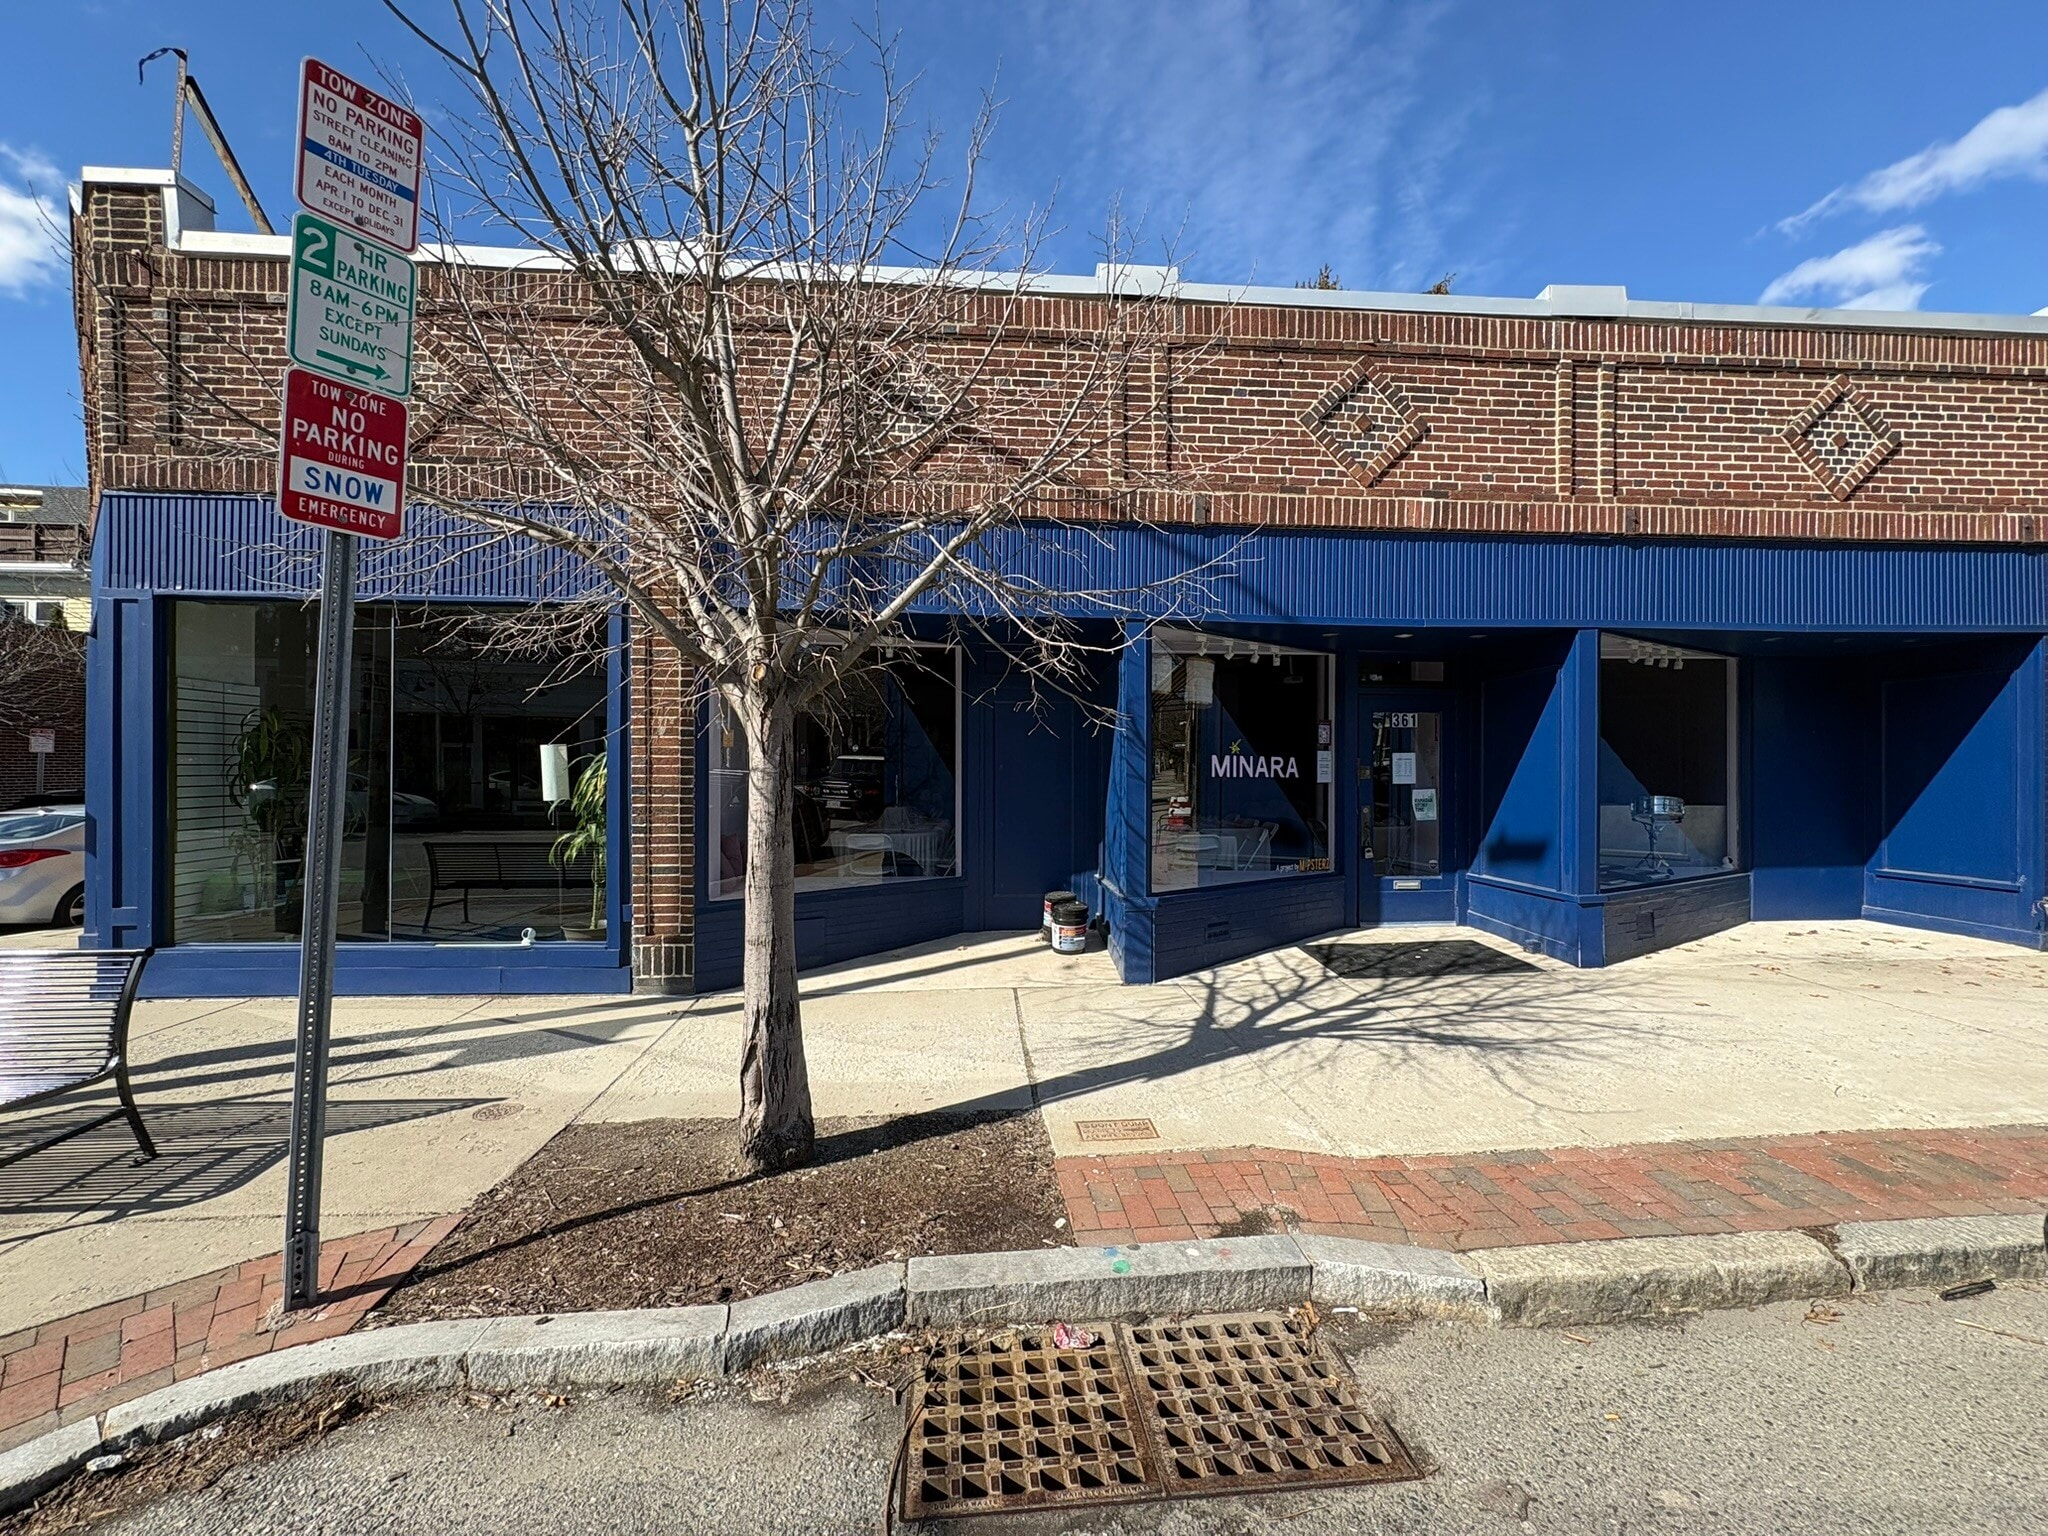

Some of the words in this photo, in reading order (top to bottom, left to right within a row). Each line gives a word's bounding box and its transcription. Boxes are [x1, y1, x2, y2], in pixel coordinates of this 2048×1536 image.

[318, 66, 357, 99] TOW
[364, 93, 413, 133] ZONE
[312, 109, 356, 139] STREET
[360, 135, 413, 170] CLEANING
[313, 88, 338, 114] NO
[345, 107, 414, 155] PARKING
[324, 150, 347, 167] 4TH
[349, 161, 399, 193] TUESDAY
[328, 134, 352, 155] 8AM
[357, 148, 370, 164] TO
[375, 158, 398, 178] 2PM
[325, 165, 355, 188] EACH
[360, 182, 397, 209] MONTH
[323, 197, 355, 218] EXCEPT
[357, 213, 395, 236] HOLIDAYS
[351, 194, 364, 209] TO
[393, 214, 404, 228] 31
[301, 226, 329, 269] 2
[360, 248, 388, 274] HR
[337, 260, 407, 304] PARKING
[325, 307, 383, 340] EXCEPT
[319, 326, 386, 361] SUNDAYS
[312, 380, 341, 402] TOW
[349, 393, 387, 417] ZONE
[332, 405, 365, 434] NO
[292, 418, 399, 466] PARKING
[328, 451, 365, 470] DURING
[304, 466, 384, 505] SNOW
[299, 497, 386, 529] EMERGENCY
[1393, 714, 1417, 727] 361
[1211, 754, 1299, 778] MINARA
